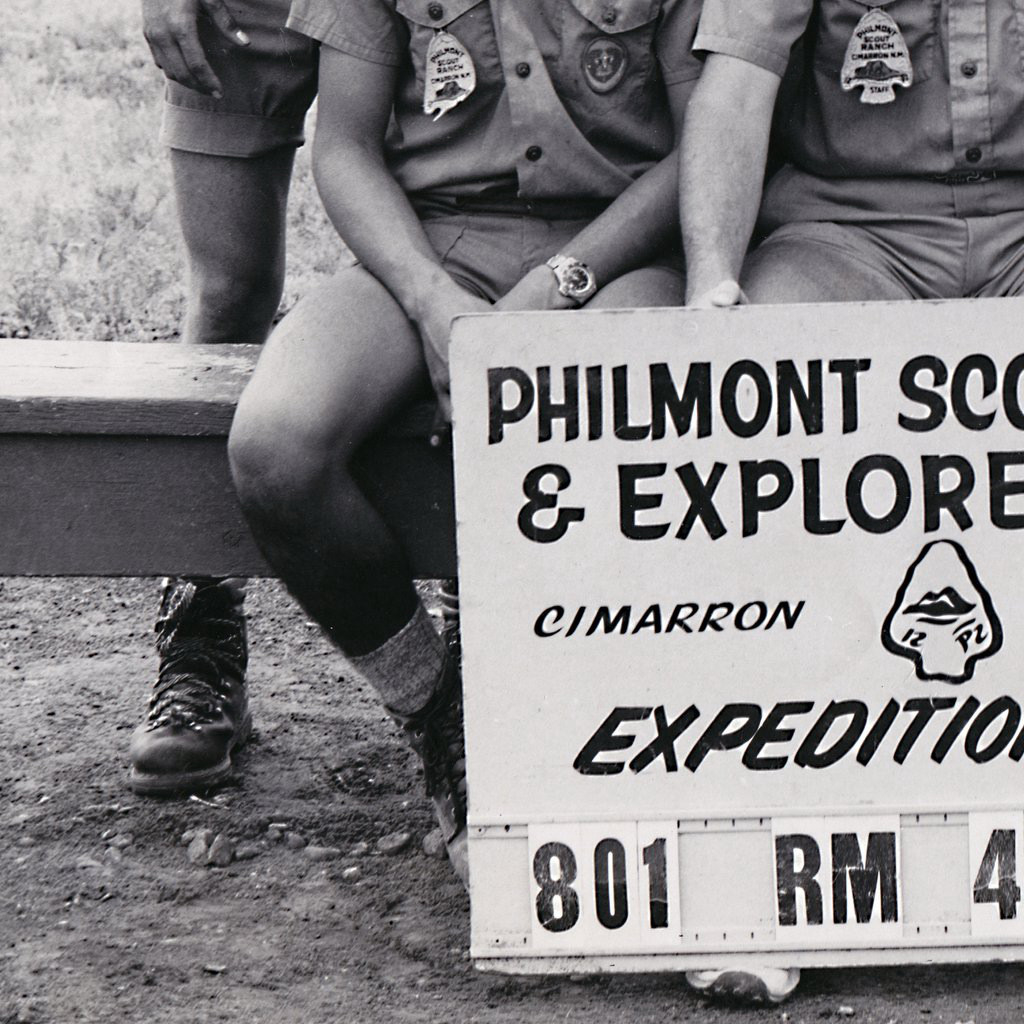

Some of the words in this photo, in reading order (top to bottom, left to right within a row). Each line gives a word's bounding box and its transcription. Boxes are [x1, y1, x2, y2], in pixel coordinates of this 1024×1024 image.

[857, 24, 898, 39] PHILMONT
[437, 57, 459, 67] SCOUT
[851, 52, 889, 60] CIMARRON
[437, 65, 464, 73] RANCH
[870, 86, 890, 94] STAFF
[488, 359, 871, 445] PHILMONT
[518, 464, 585, 543] &
[534, 601, 805, 637] CIMARRON
[534, 838, 668, 932] 801
[776, 832, 898, 925] RM
[974, 830, 1020, 919] 4
